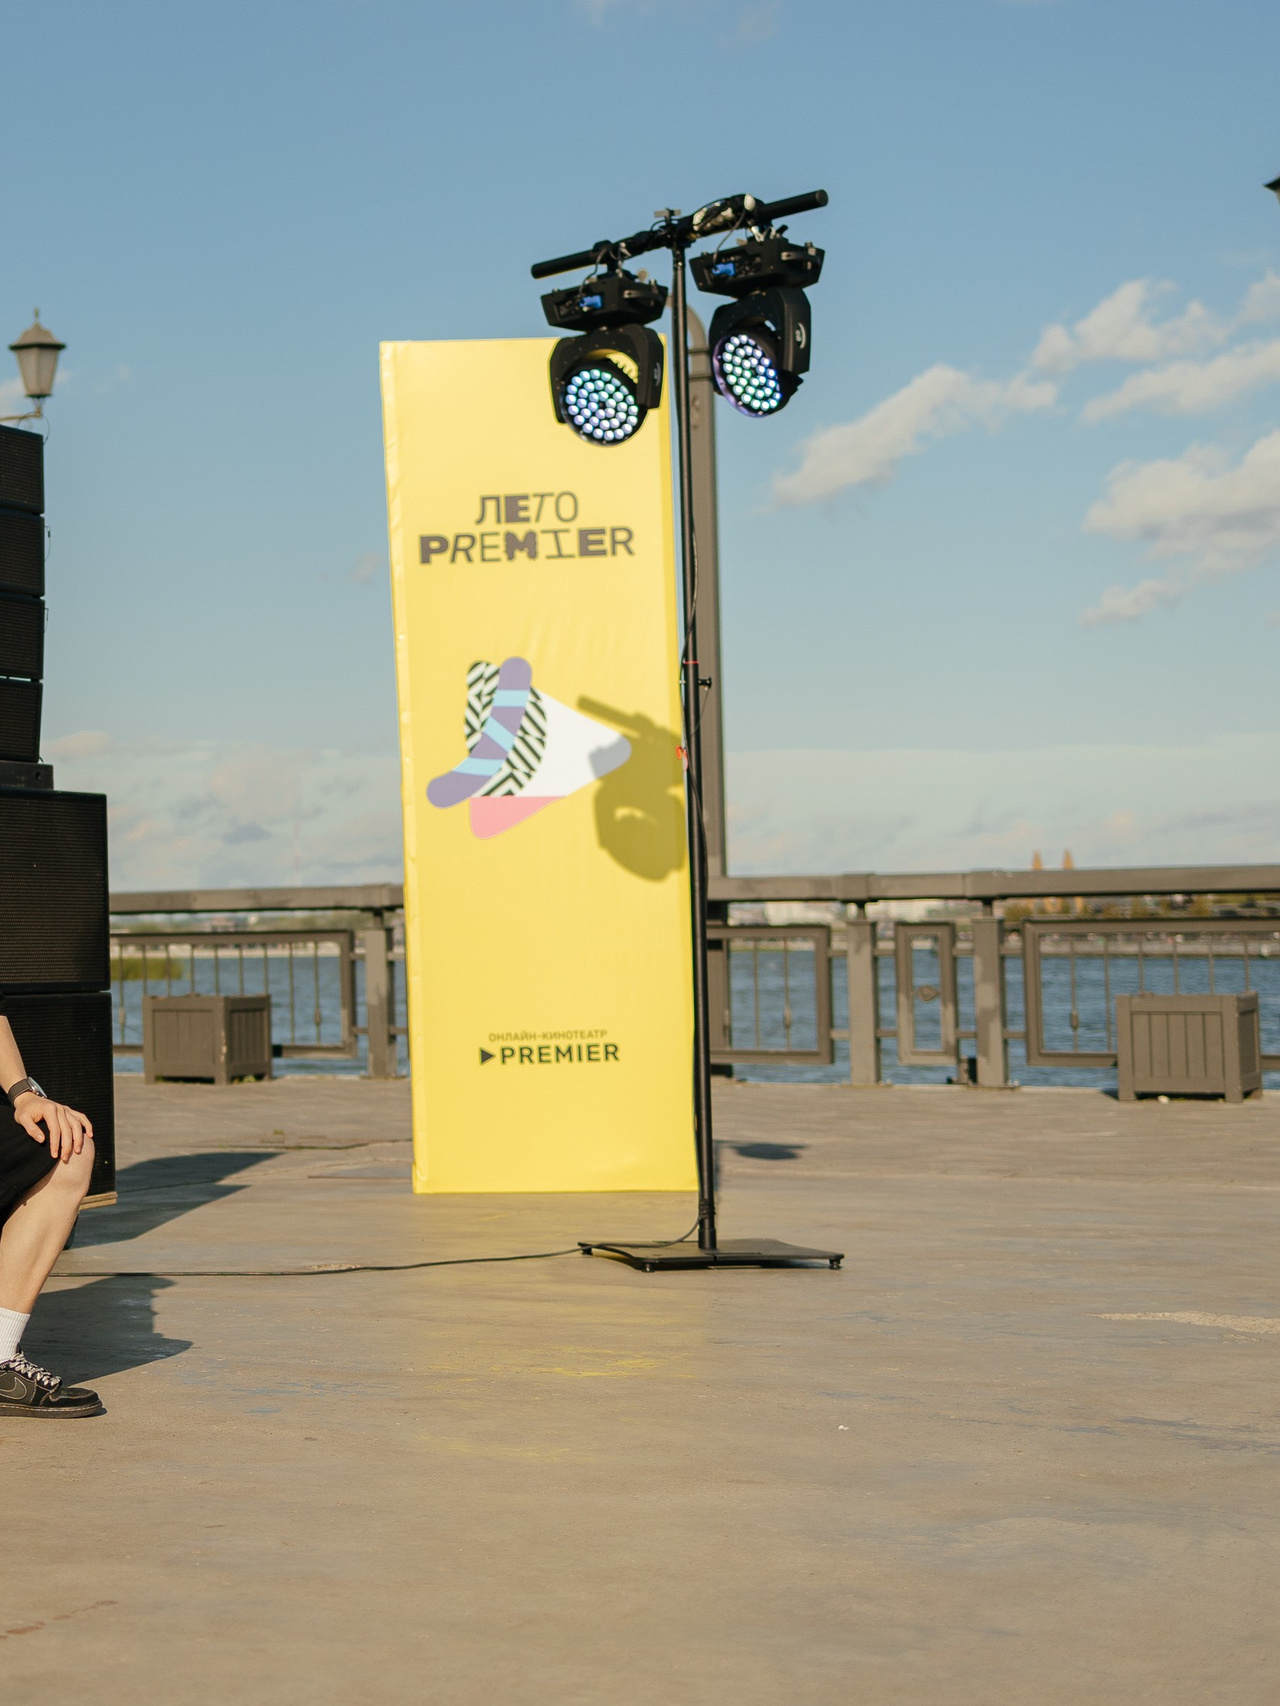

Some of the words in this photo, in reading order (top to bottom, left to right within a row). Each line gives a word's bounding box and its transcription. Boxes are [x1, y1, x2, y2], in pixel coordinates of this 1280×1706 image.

[475, 490, 579, 525] ЛЕТО
[418, 526, 635, 565] PREMIER
[488, 1029, 608, 1042] ОНЛАЙН-КИНОТЕАТР
[500, 1043, 620, 1065] PREMIER
